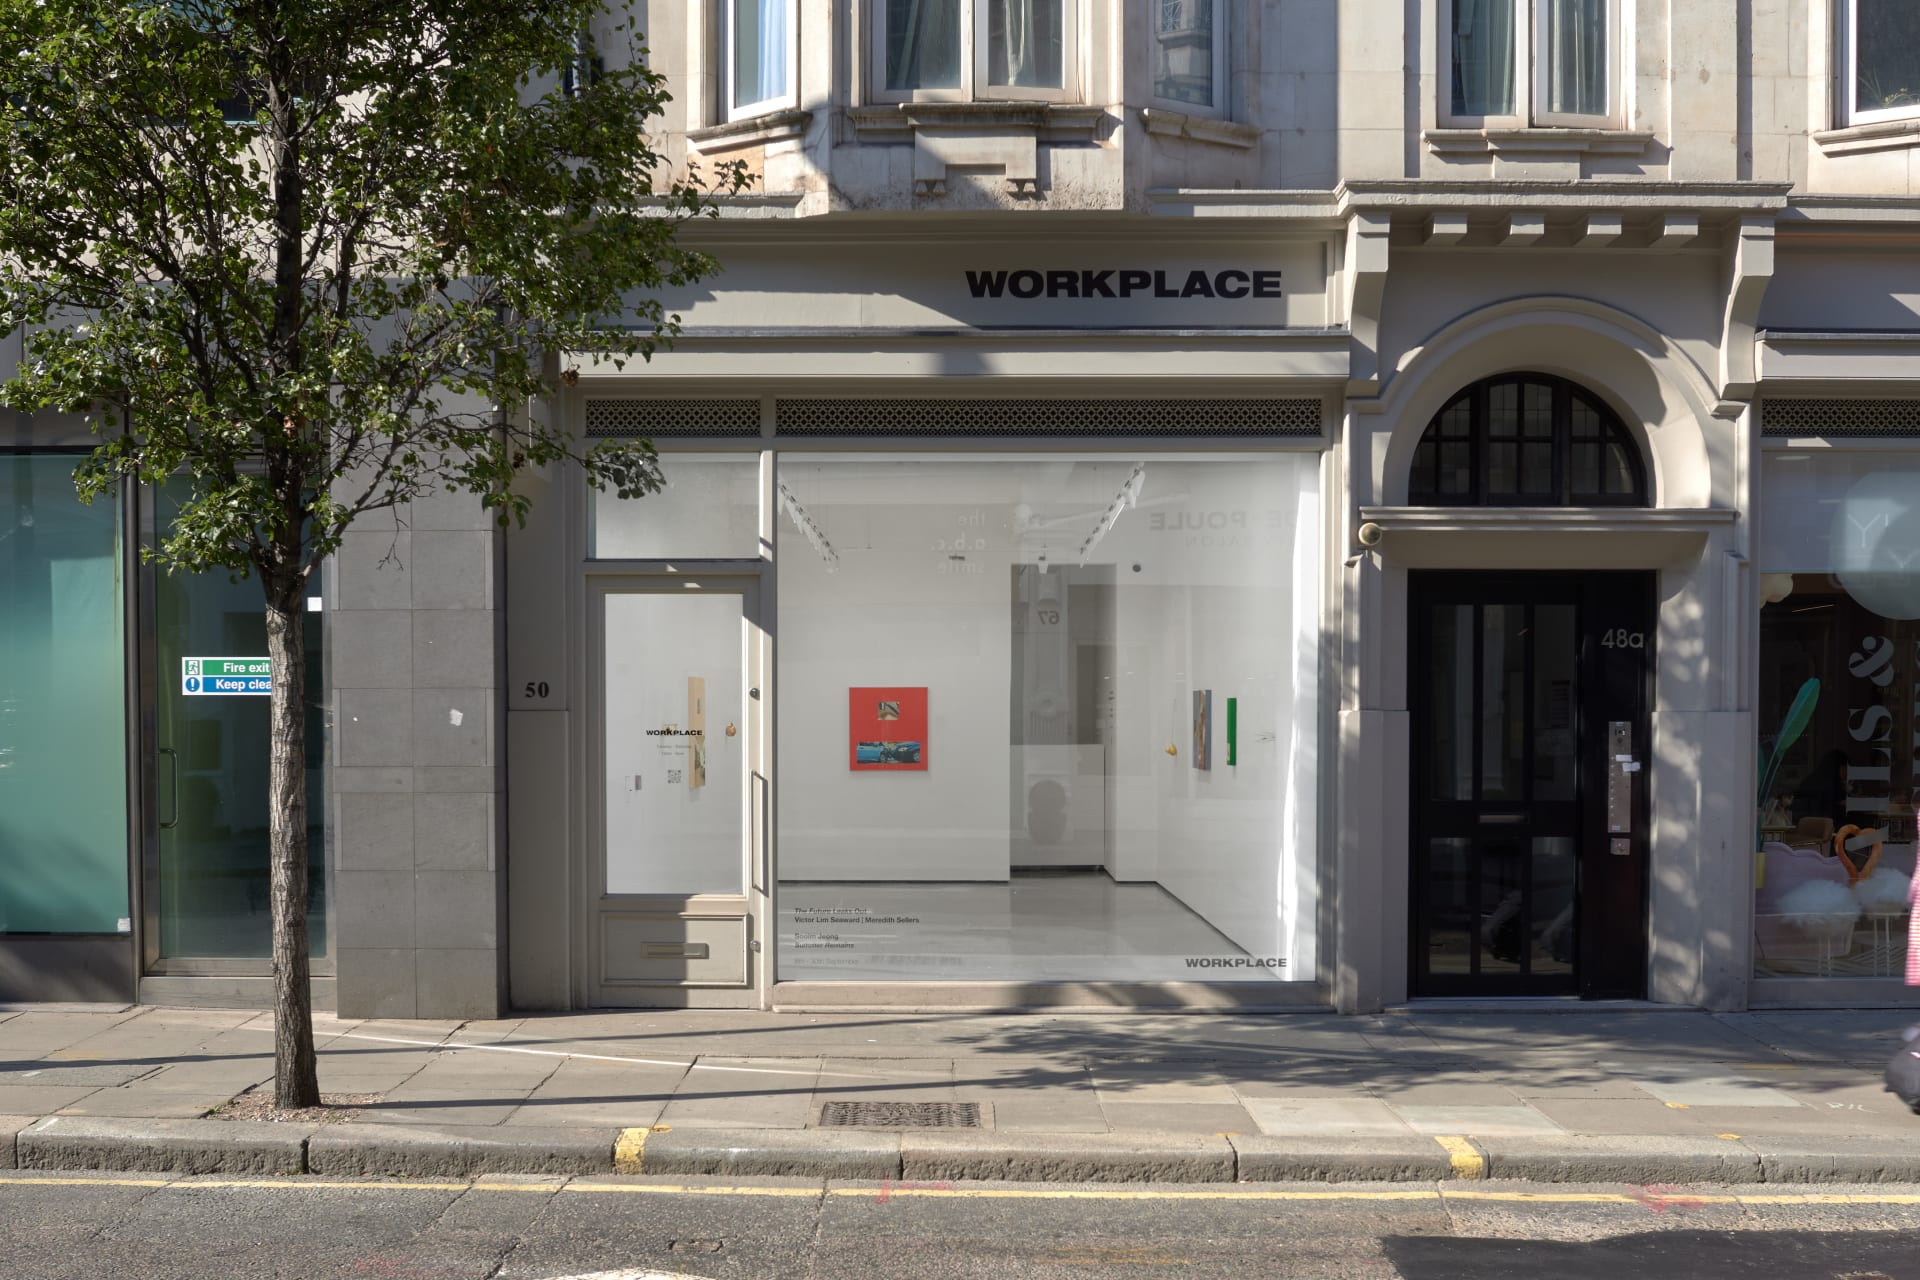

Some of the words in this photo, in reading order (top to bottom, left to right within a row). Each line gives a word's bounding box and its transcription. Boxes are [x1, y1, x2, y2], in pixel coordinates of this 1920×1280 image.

[965, 270, 1282, 298] WORKPLACE
[1600, 629, 1644, 648] 48a
[223, 662, 246, 673] Fire
[248, 662, 270, 673] exit
[1848, 635, 1895, 687] &
[215, 679, 246, 692] Keep
[248, 679, 272, 690] clea
[525, 682, 550, 698] 50
[1185, 958, 1287, 968] WORKPLACE
